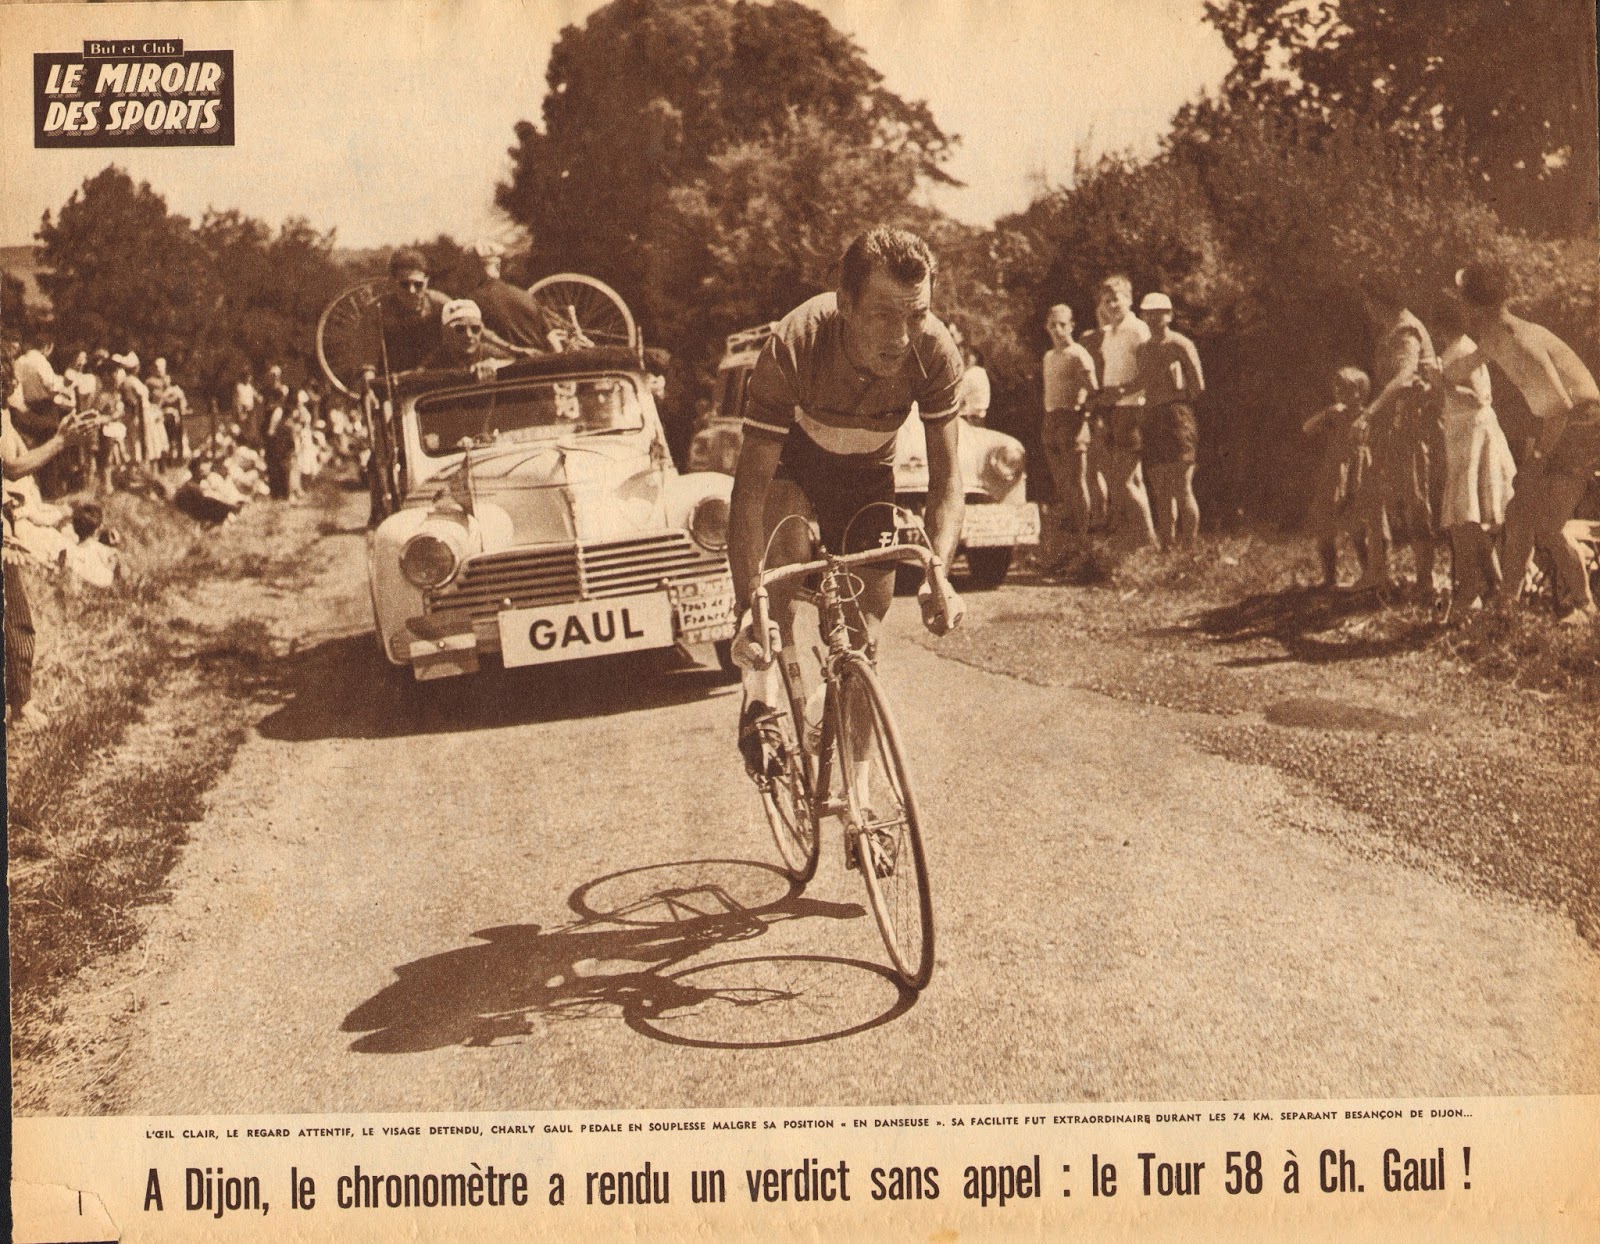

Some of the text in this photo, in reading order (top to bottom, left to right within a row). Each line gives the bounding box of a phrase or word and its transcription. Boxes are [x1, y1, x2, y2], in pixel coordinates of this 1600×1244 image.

[90, 43, 176, 55] But et Club
[44, 61, 225, 96] LE MIROIR
[43, 99, 222, 134] DES SPORTS
[528, 608, 644, 651] GAUL
[182, 1129, 219, 1140] CLAIR,
[226, 1129, 239, 1138] LE
[246, 1128, 291, 1138] REGARD
[298, 1127, 355, 1138] ATTENTIF,
[362, 1127, 374, 1136] LE
[382, 1126, 421, 1136] VISAGE
[429, 1125, 483, 1137] DETENDU,
[490, 1125, 536, 1135] CHARLY
[543, 1124, 573, 1134] GAUL
[580, 1123, 623, 1133] PEDALE
[628, 1123, 643, 1132] EN
[648, 1121, 706, 1132] SOUPLESSE
[712, 1120, 757, 1130] MALGRE
[763, 1120, 777, 1130] SA
[783, 1119, 834, 1129] POSITION
[853, 1119, 868, 1128] EN
[874, 1118, 930, 1128] DANSEUSE
[951, 1117, 965, 1127] SA
[970, 1116, 1019, 1126] FACILITE
[1024, 1116, 1047, 1125] FUT
[1155, 1113, 1202, 1123] DURANT
[1209, 1113, 1226, 1122] LES
[1233, 1112, 1246, 1121] 74
[1253, 1112, 1274, 1122] KM.
[1280, 1111, 1338, 1121] SEPARANT
[1410, 1109, 1424, 1118] DE
[144, 1147, 1470, 1218] A Dijon, le chronomètre a rendu un verdict sans appel : le Tour 58 à Ch. Gaul !
